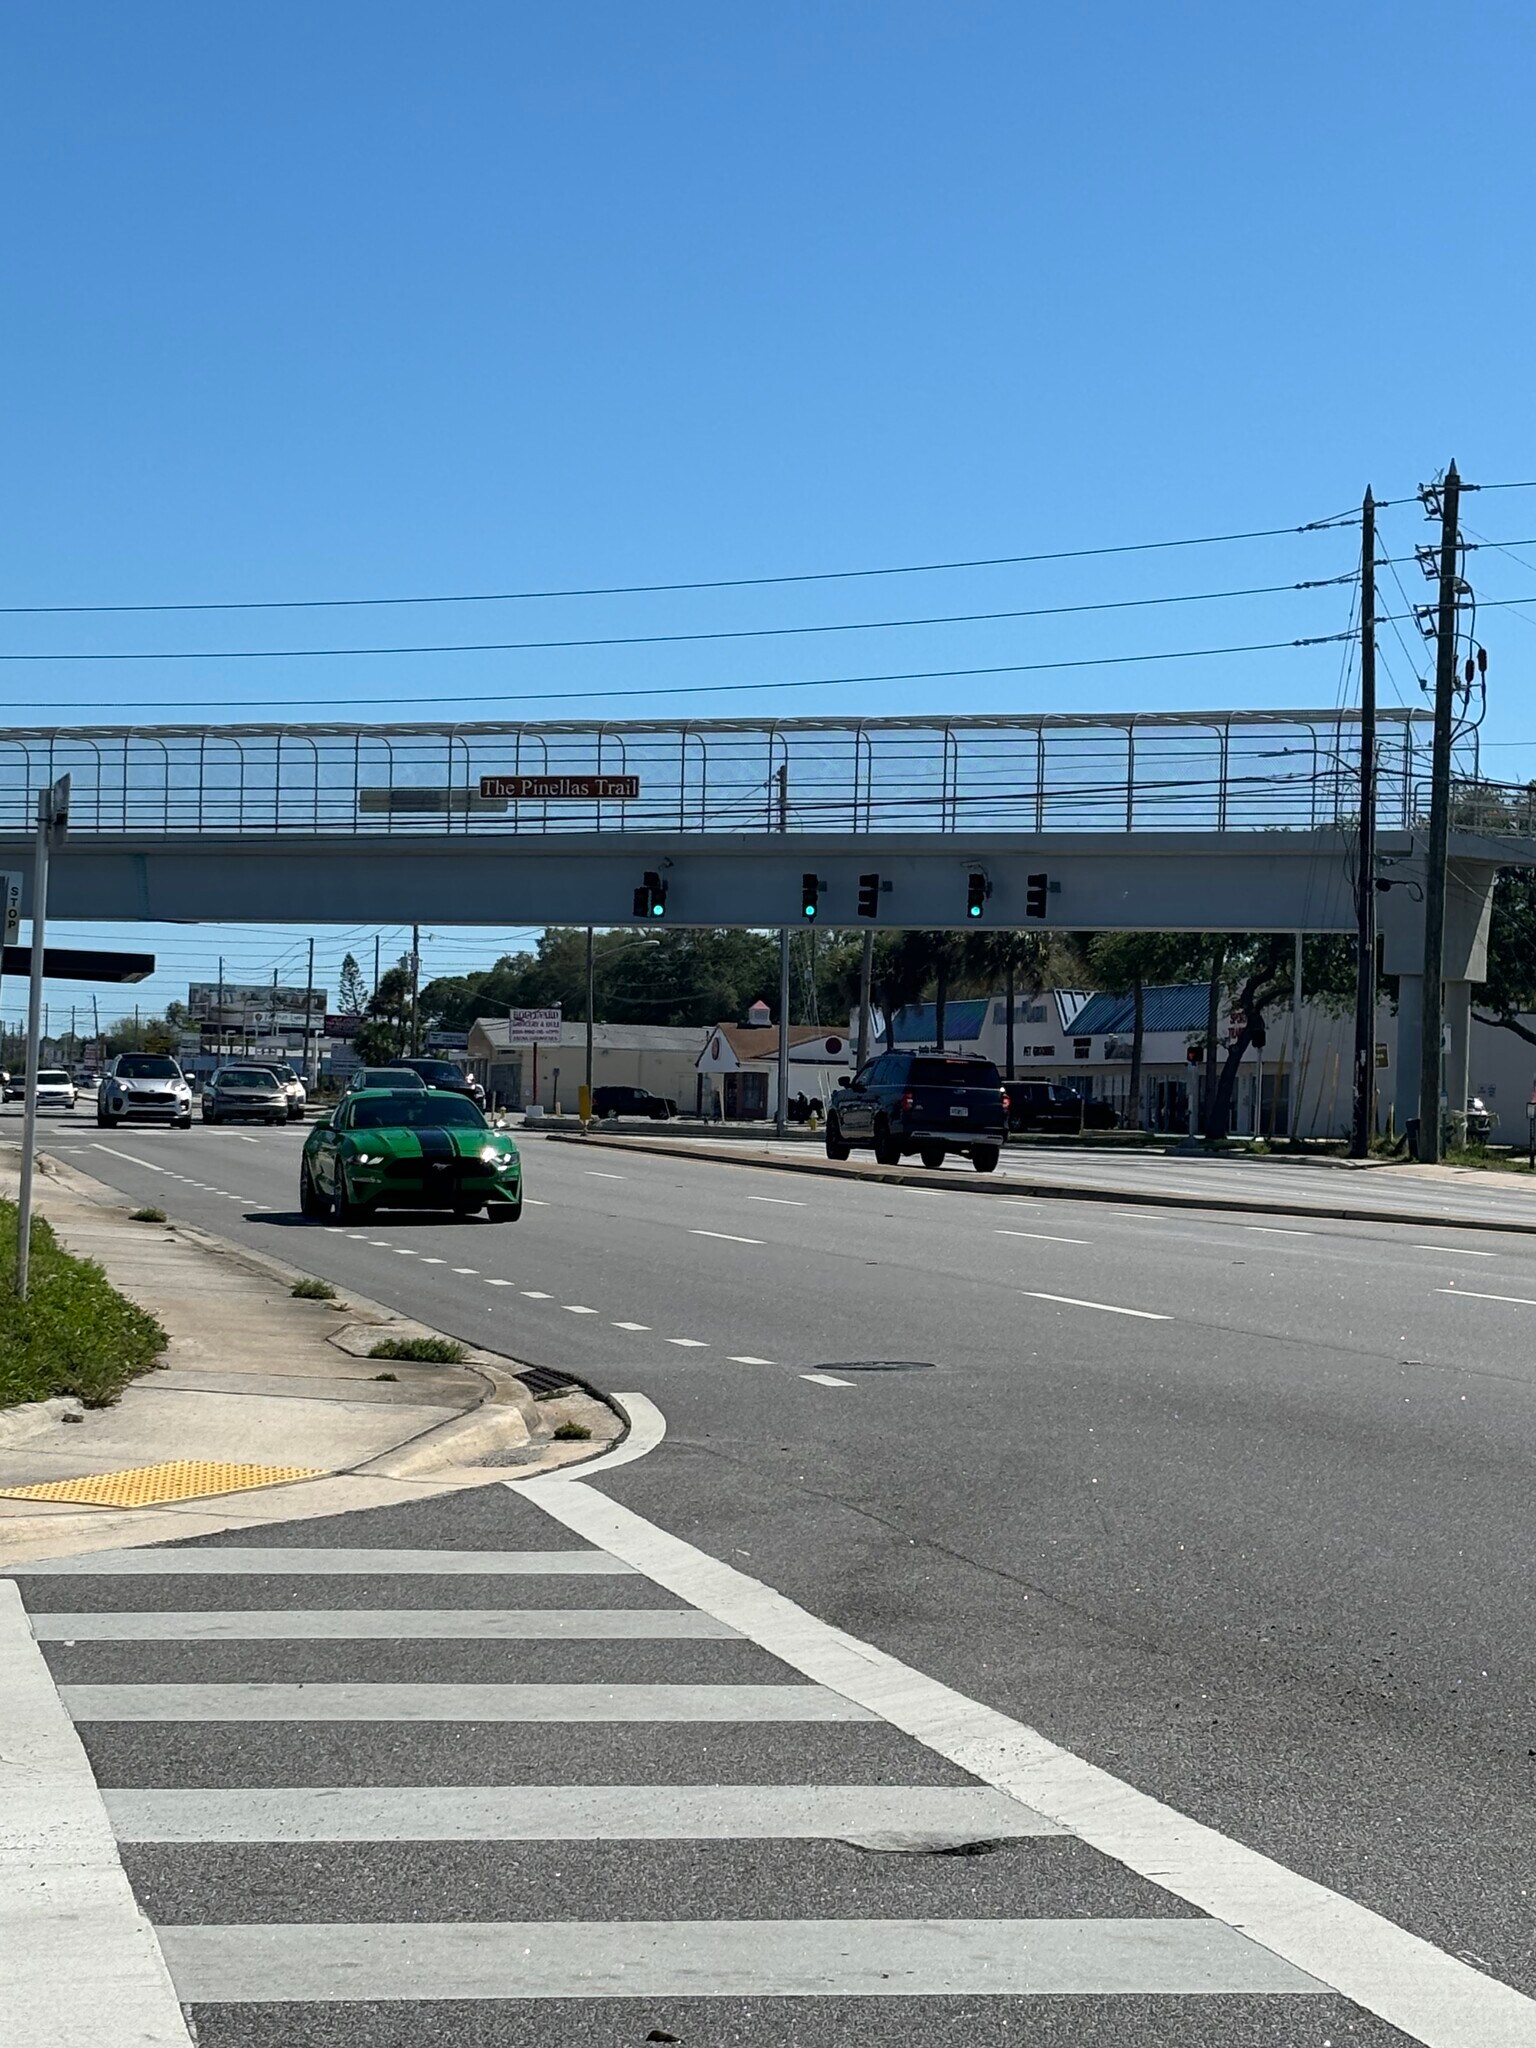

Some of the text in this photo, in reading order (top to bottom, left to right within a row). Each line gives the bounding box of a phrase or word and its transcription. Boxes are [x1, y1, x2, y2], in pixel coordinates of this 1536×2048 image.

[482, 778, 637, 796] The Pinellas Trail
[8, 887, 19, 928] STOP
